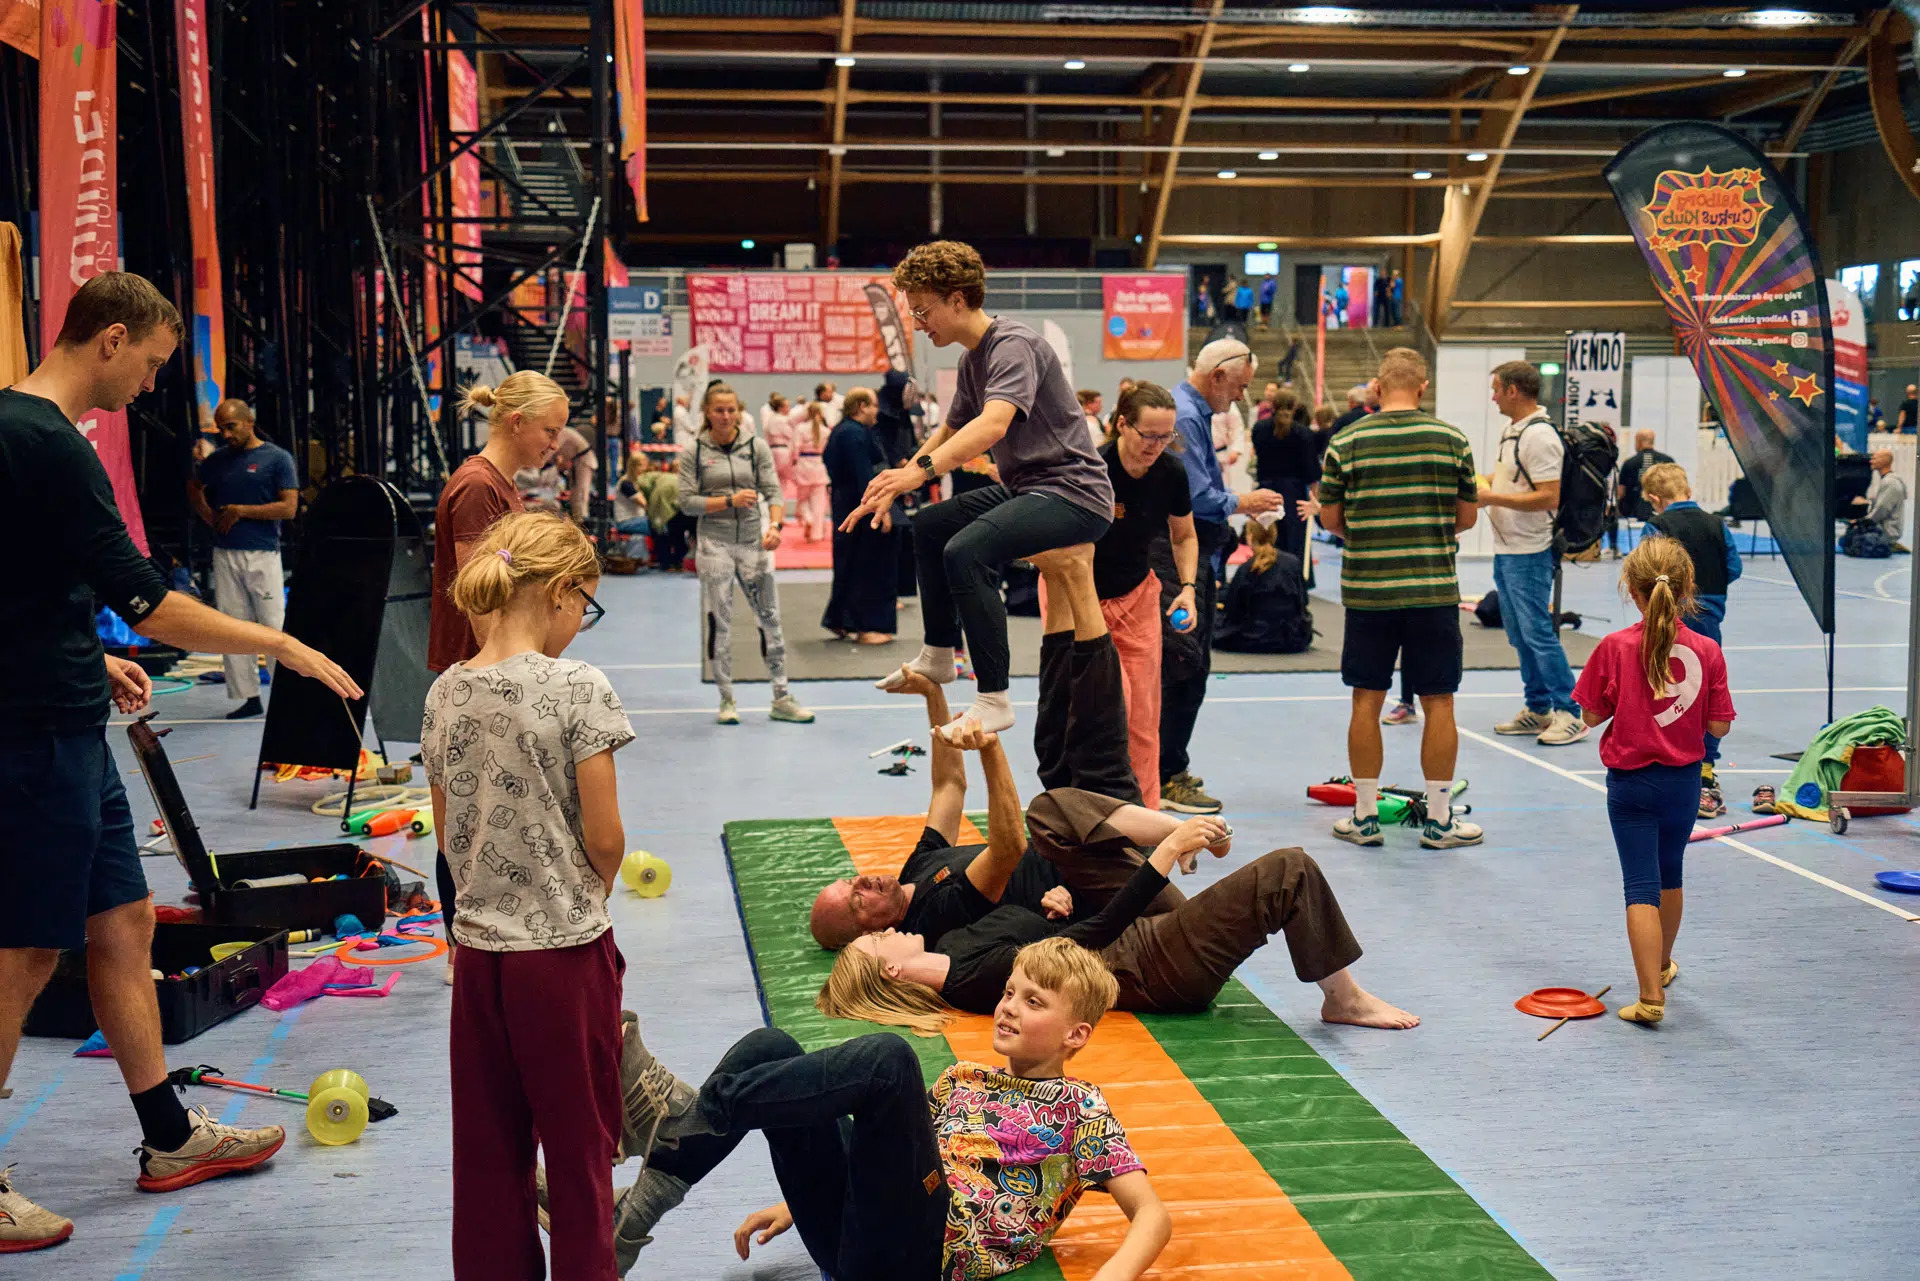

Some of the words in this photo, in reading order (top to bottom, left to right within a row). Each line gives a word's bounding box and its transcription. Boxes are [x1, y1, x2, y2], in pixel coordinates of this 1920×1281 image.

[644, 291, 660, 309] D
[749, 302, 803, 321] DREAM
[805, 302, 820, 320] IT
[1568, 338, 1621, 371] KENDO
[1567, 376, 1580, 406] JOIN
[1567, 408, 1580, 431] TH
[1650, 643, 1703, 728] 9
